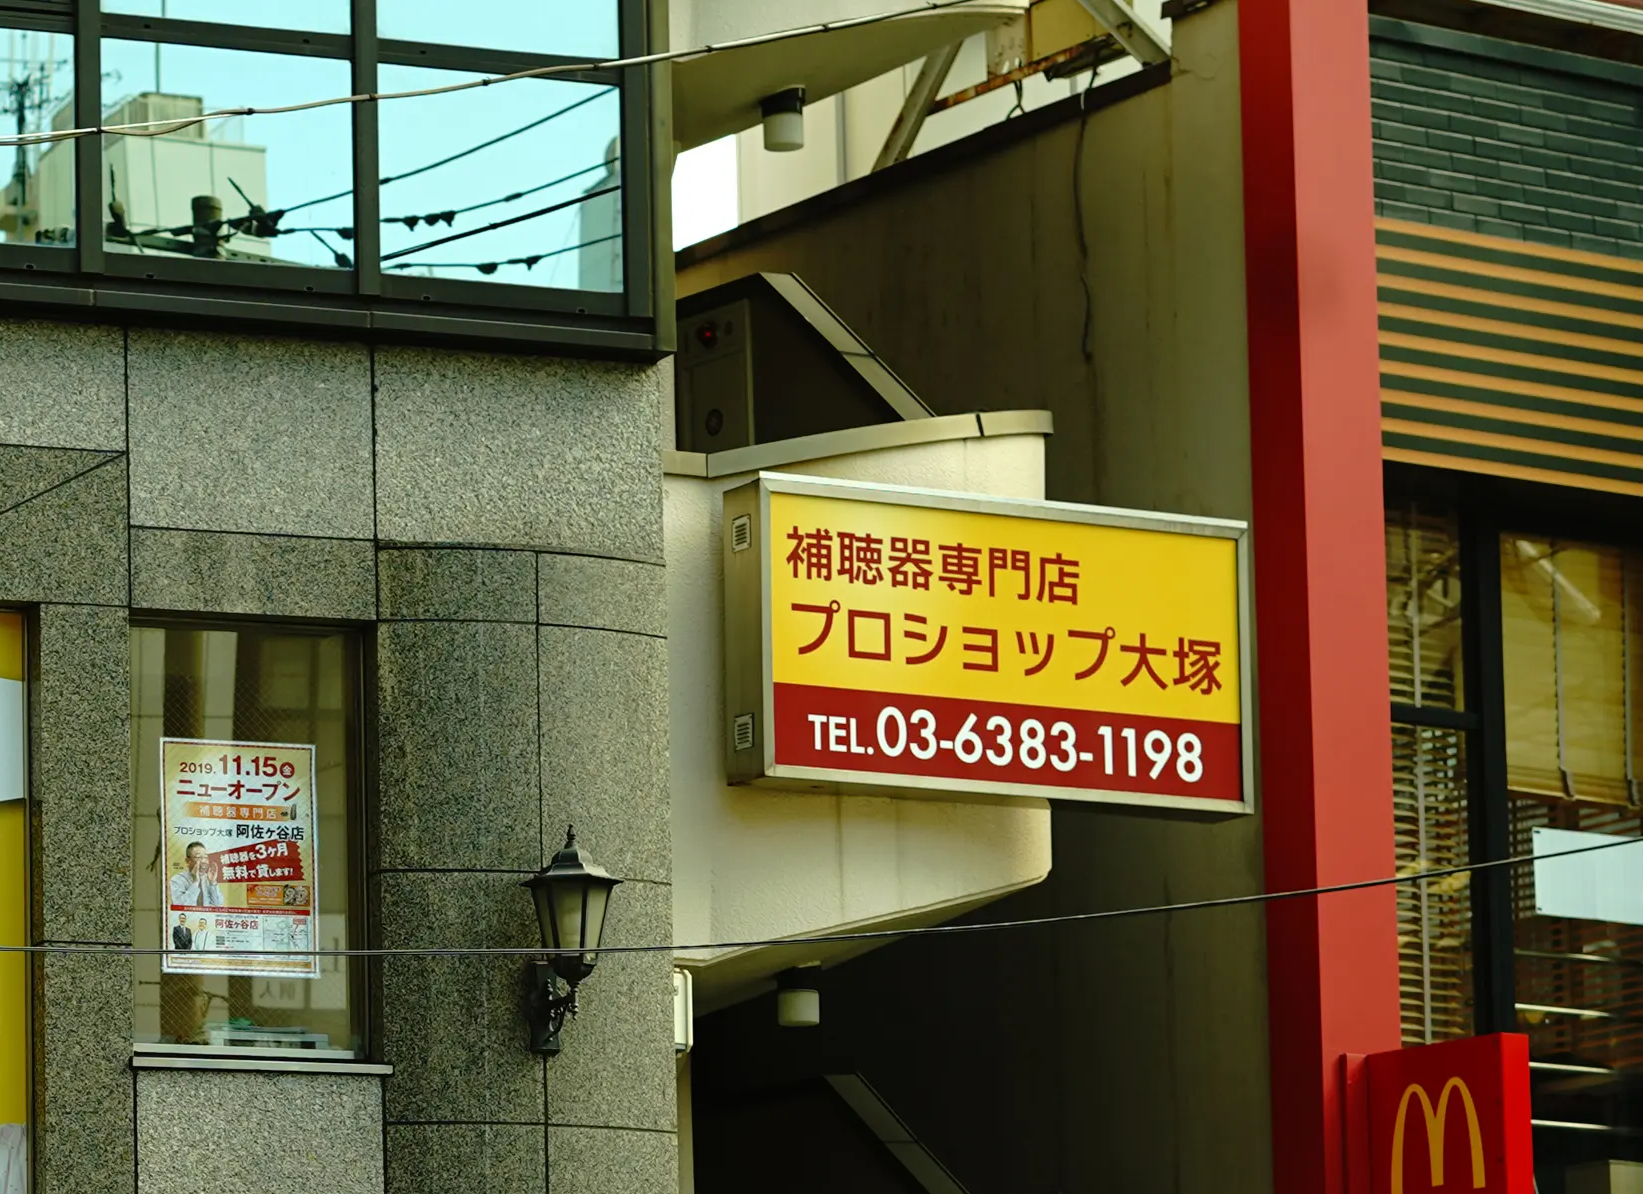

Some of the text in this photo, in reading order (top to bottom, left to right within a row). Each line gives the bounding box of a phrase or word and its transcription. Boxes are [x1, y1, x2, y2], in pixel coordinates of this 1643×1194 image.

[786, 525, 1080, 605] 補聴器専門店
[789, 600, 1222, 695] プロショップ大塚
[808, 706, 1203, 783] TEL.03-6383-1198
[177, 779, 300, 801] ニューオープン
[199, 805, 277, 819] 補聴器専門店
[174, 824, 304, 840] プロショップ大塚 阿佐ヶ谷店
